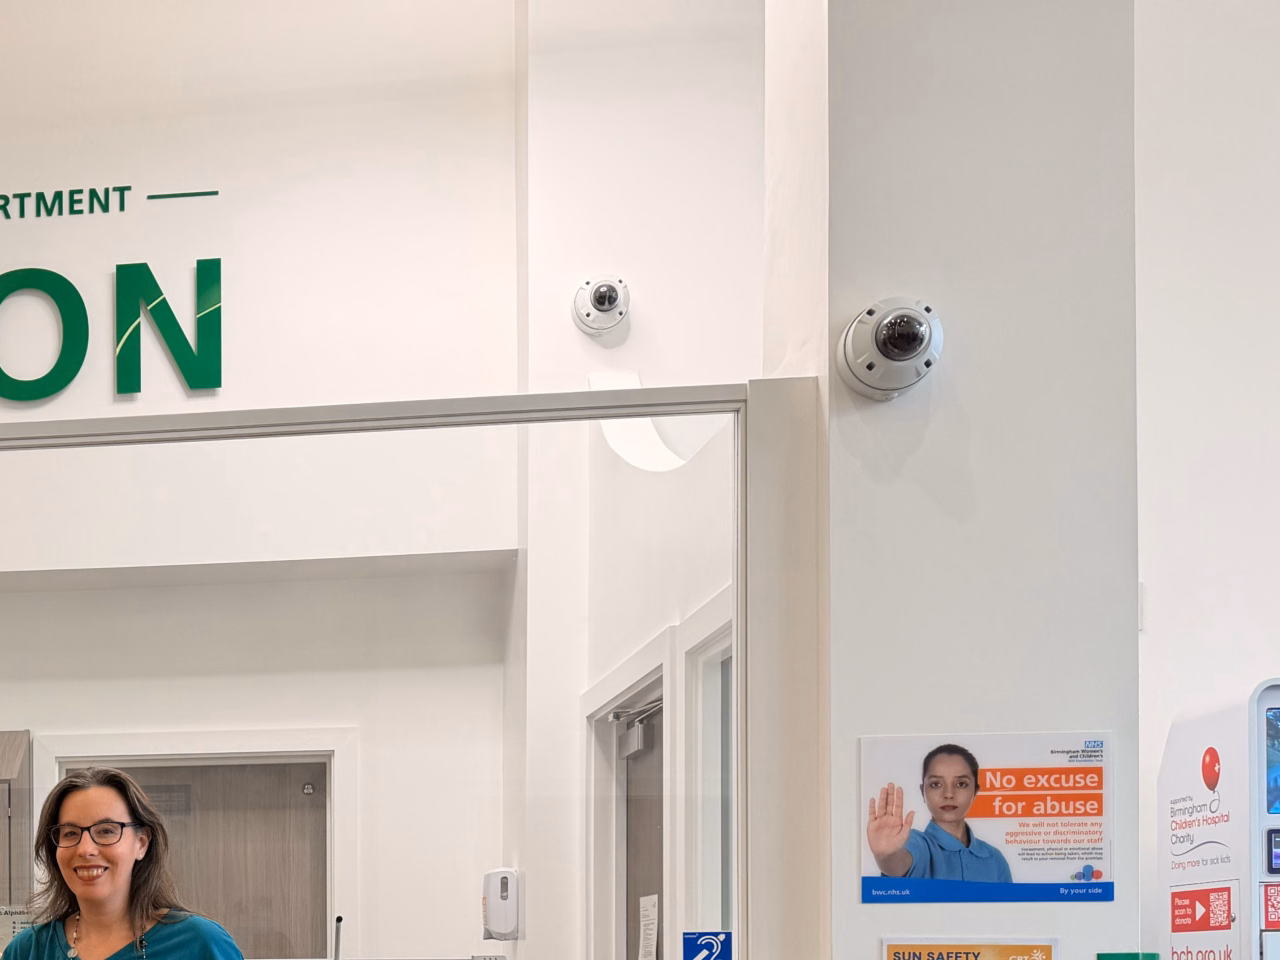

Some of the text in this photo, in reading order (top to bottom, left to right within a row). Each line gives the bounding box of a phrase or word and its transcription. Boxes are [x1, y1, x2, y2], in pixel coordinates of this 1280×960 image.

[986, 771, 1099, 788] No excuse
[993, 797, 1099, 814] for abuse
[1171, 804, 1207, 817] Birmingham
[1171, 811, 1230, 831] Children's Hospital
[1171, 833, 1194, 845] Charity
[1172, 861, 1186, 870] Doing
[1187, 860, 1200, 868] more
